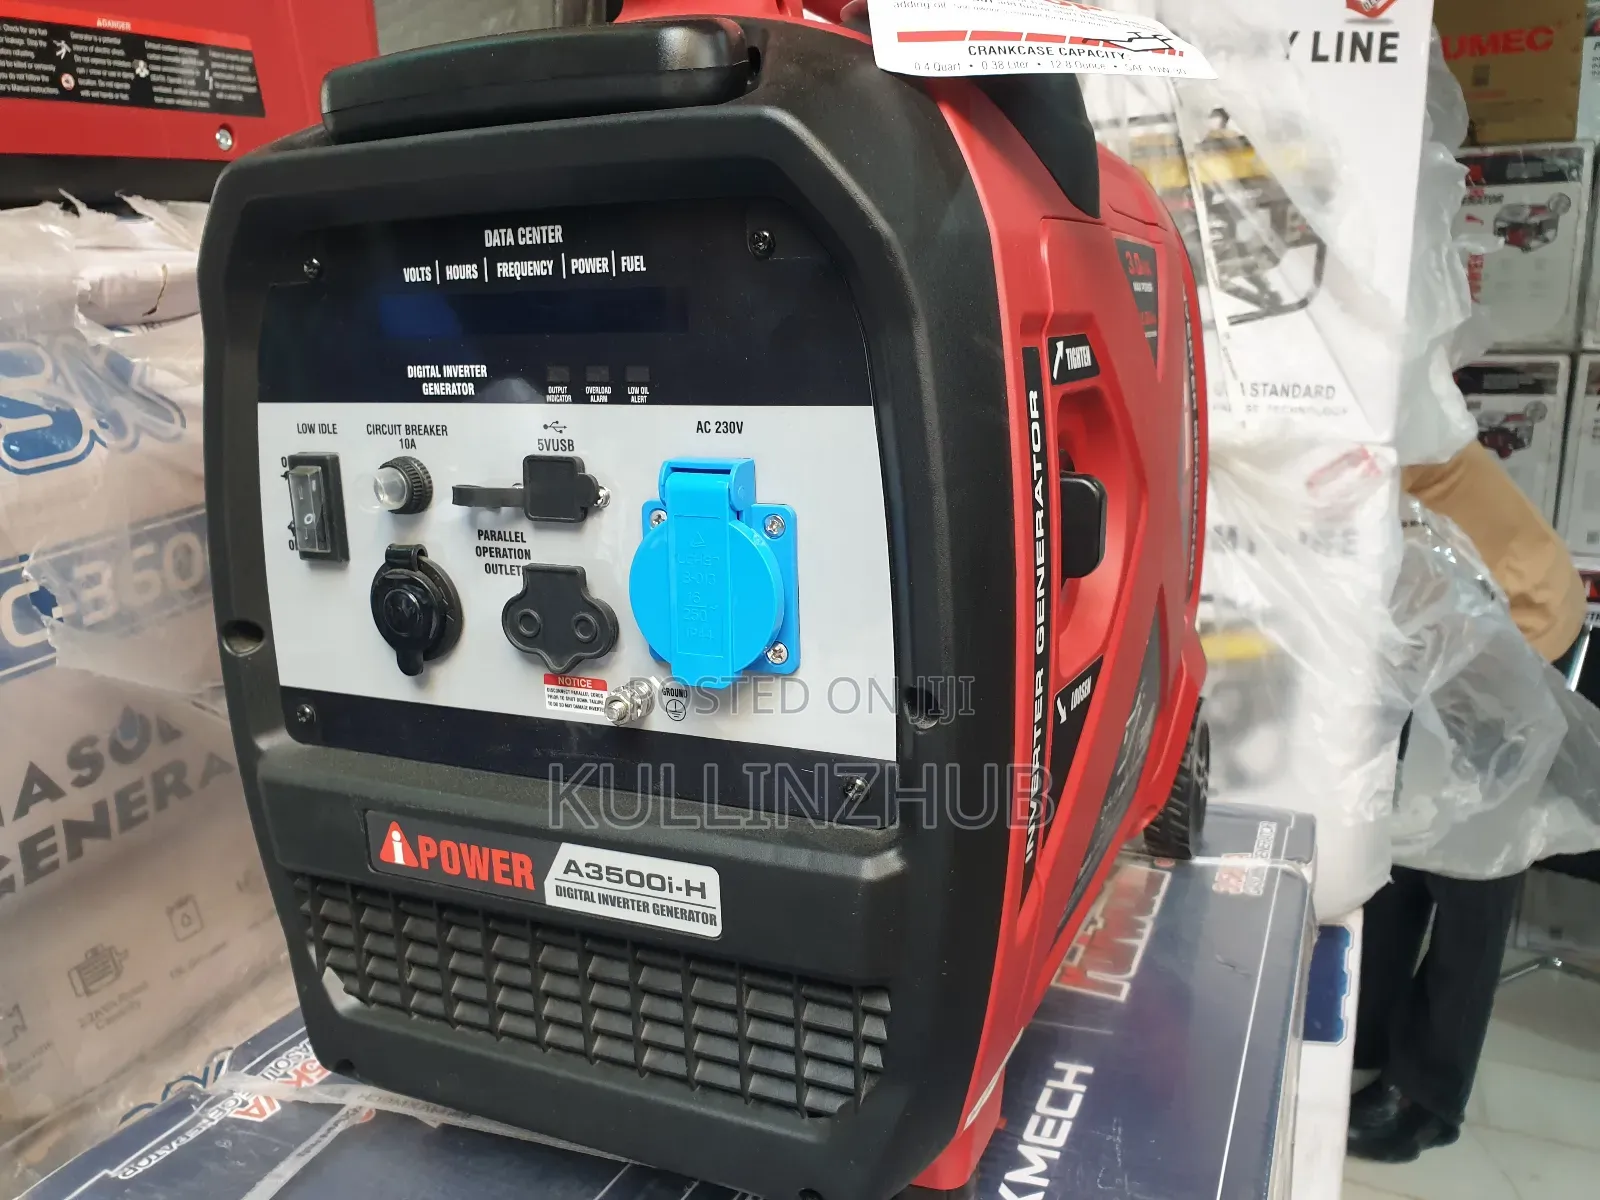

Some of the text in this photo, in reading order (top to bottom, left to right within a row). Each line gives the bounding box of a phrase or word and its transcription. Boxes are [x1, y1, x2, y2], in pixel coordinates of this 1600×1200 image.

[968, 45, 1054, 56] CRANKCASE
[1311, 31, 1399, 63] LINE
[933, 62, 961, 71] Quart
[484, 225, 563, 248] DATA CENTER
[403, 255, 646, 282] VOLTS HOURS FREQUENCY POWER FUEL
[1066, 345, 1092, 370] TIGHTEN
[407, 364, 488, 378] DIGITAL INVERTER
[422, 382, 475, 396] GENERATOR
[548, 386, 568, 394] OUTPUT
[585, 386, 612, 395] OVERLOAD
[627, 386, 650, 395] LOW OIL
[1250, 382, 1336, 399] STANDARD
[546, 394, 572, 403] INDICATOR
[590, 394, 608, 403] ALARM
[630, 395, 648, 404] ALERT
[297, 423, 338, 435] LOW IDLE
[366, 423, 448, 437] CIRCUIT BREAKER
[696, 421, 744, 434] AC 230V
[399, 438, 417, 450] 10A
[537, 438, 575, 452] 5VUSB
[478, 529, 527, 543] PARALLEL
[475, 546, 532, 561] OPERATION
[484, 562, 525, 577] OUTLET
[1025, 390, 1047, 865] INVERTER GENERATOR
[558, 676, 593, 689] NOTICE
[662, 686, 688, 698] GROUND
[1070, 675, 1092, 712] LOOSEN
[562, 859, 707, 900] A3500i-H
[555, 885, 718, 927] DIGITAL INVERTER GENERATOR
